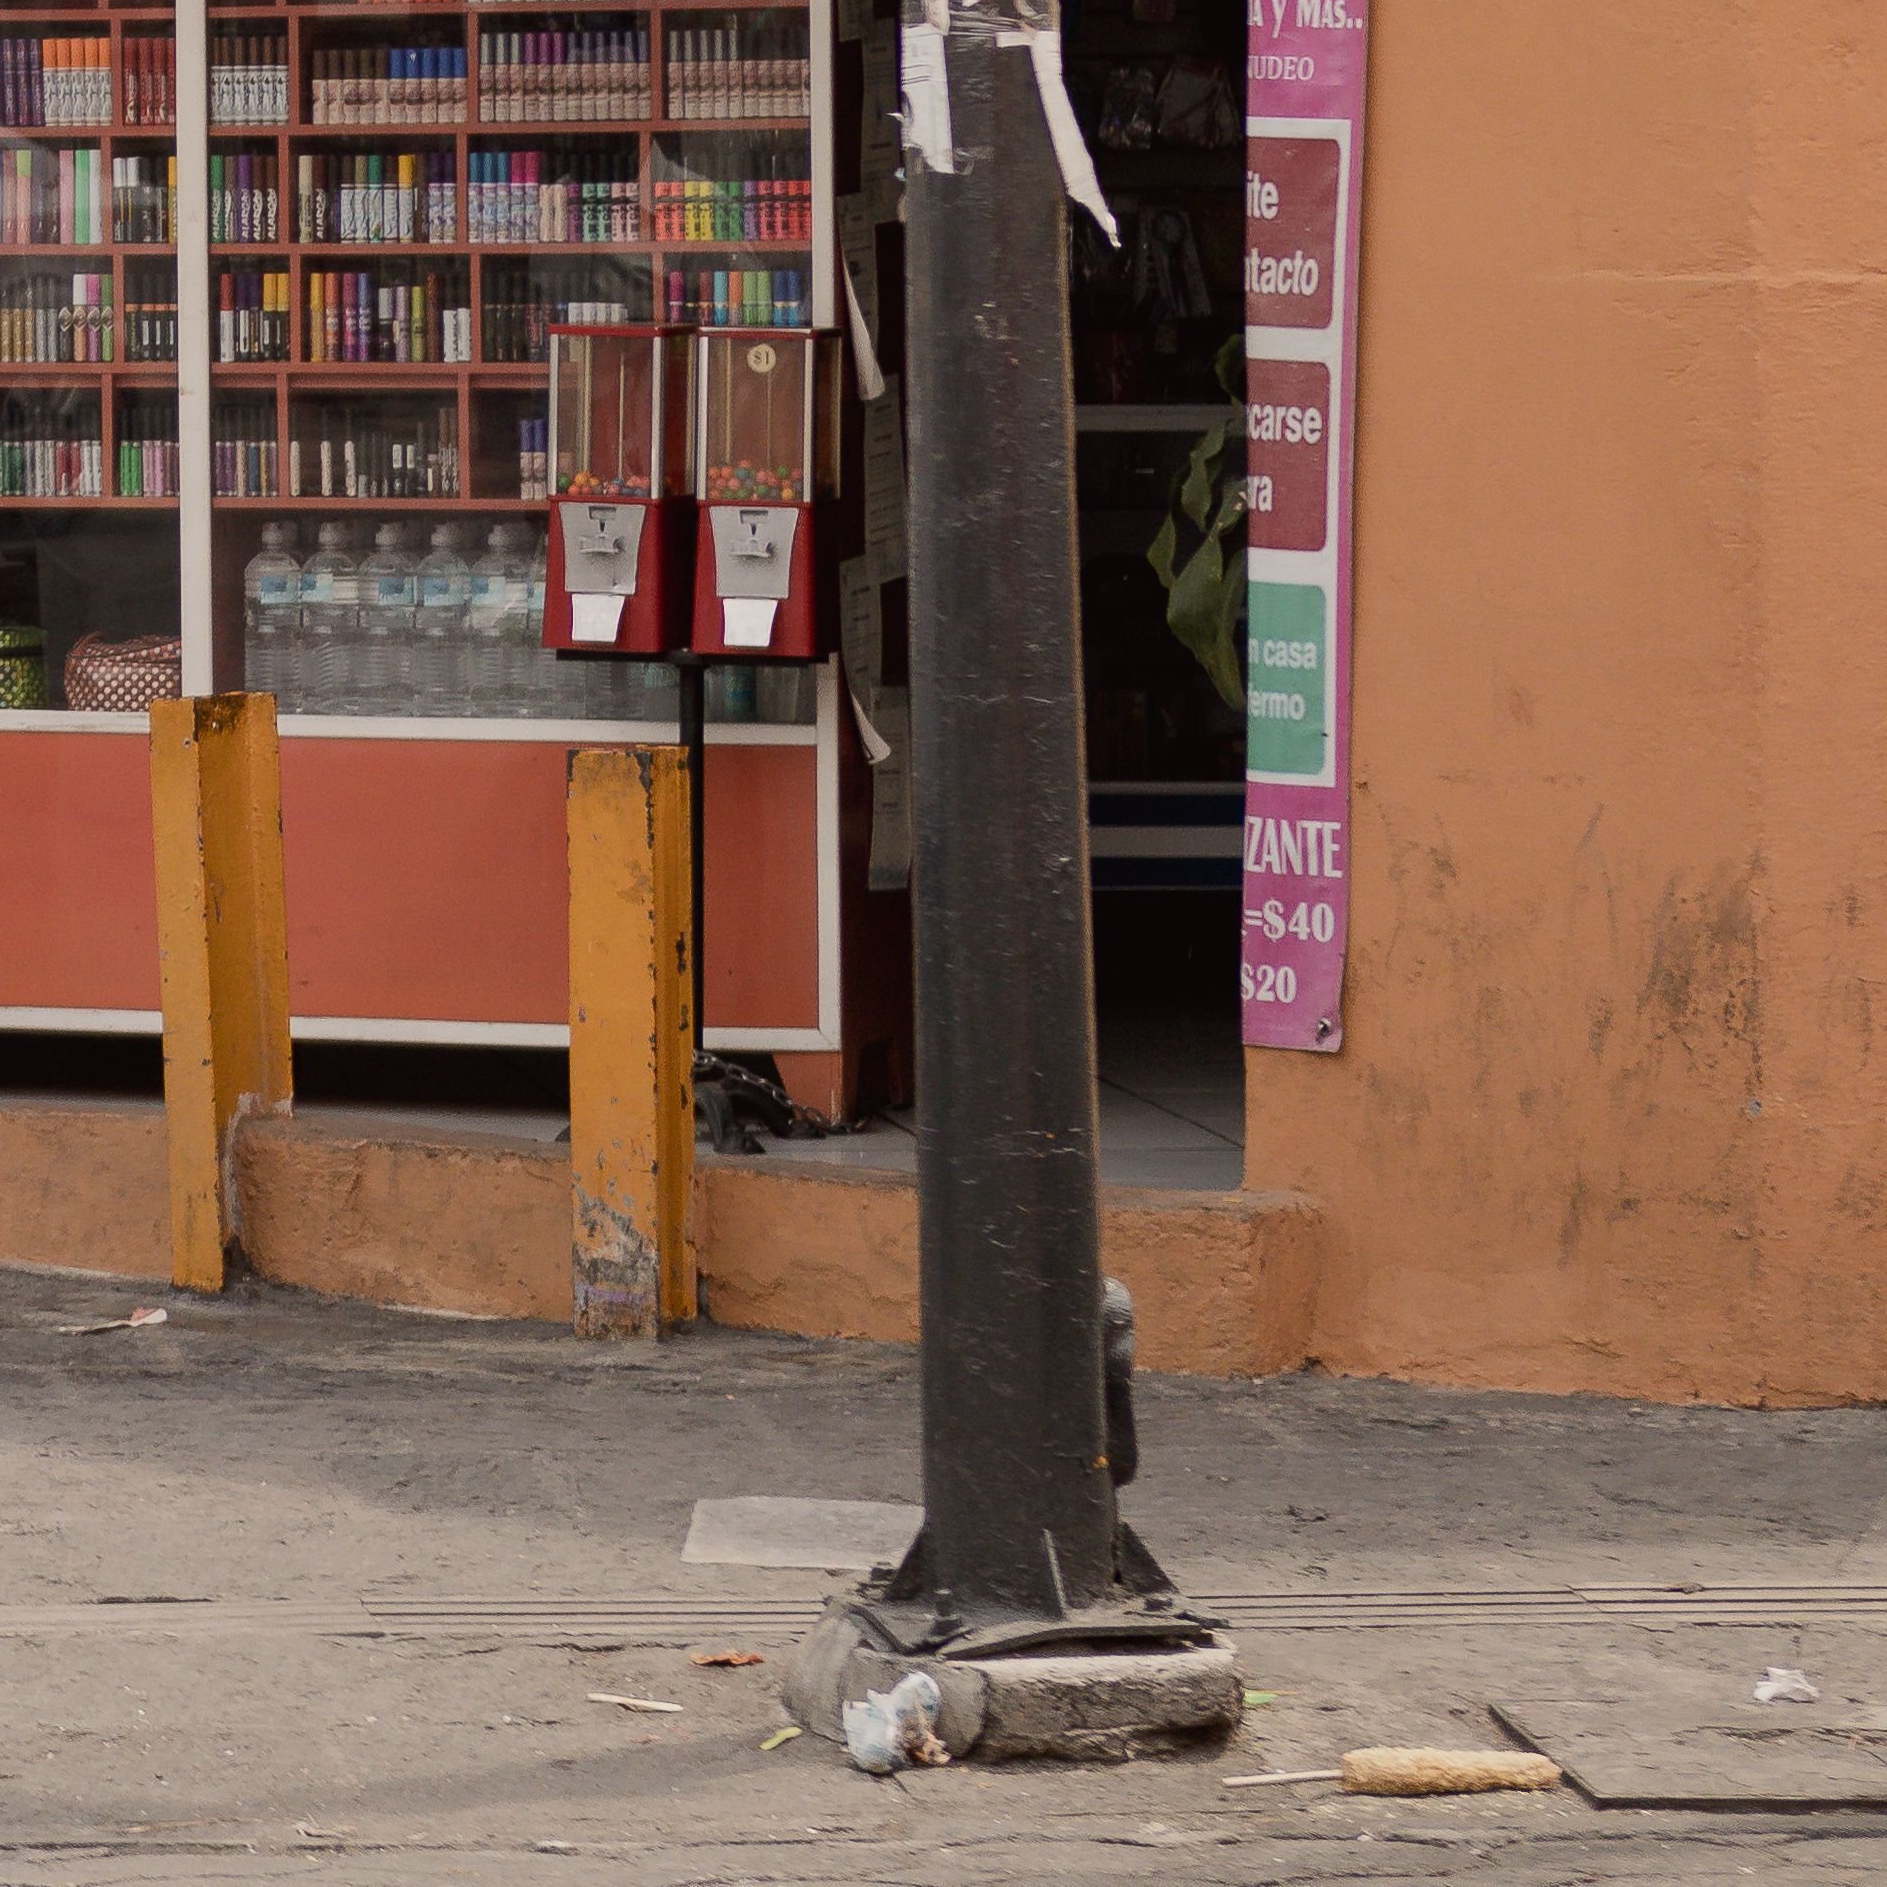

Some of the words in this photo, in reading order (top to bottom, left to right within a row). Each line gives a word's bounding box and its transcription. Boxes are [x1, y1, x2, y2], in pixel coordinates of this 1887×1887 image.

[1246, 170, 1279, 220] ite
[1245, 248, 1319, 296] tacto
[1247, 404, 1323, 444] carse
[1263, 640, 1316, 669] casa
[1248, 684, 1306, 721] ermo
[1245, 815, 1342, 878] ZANTE
[1241, 897, 1335, 943] =$40
